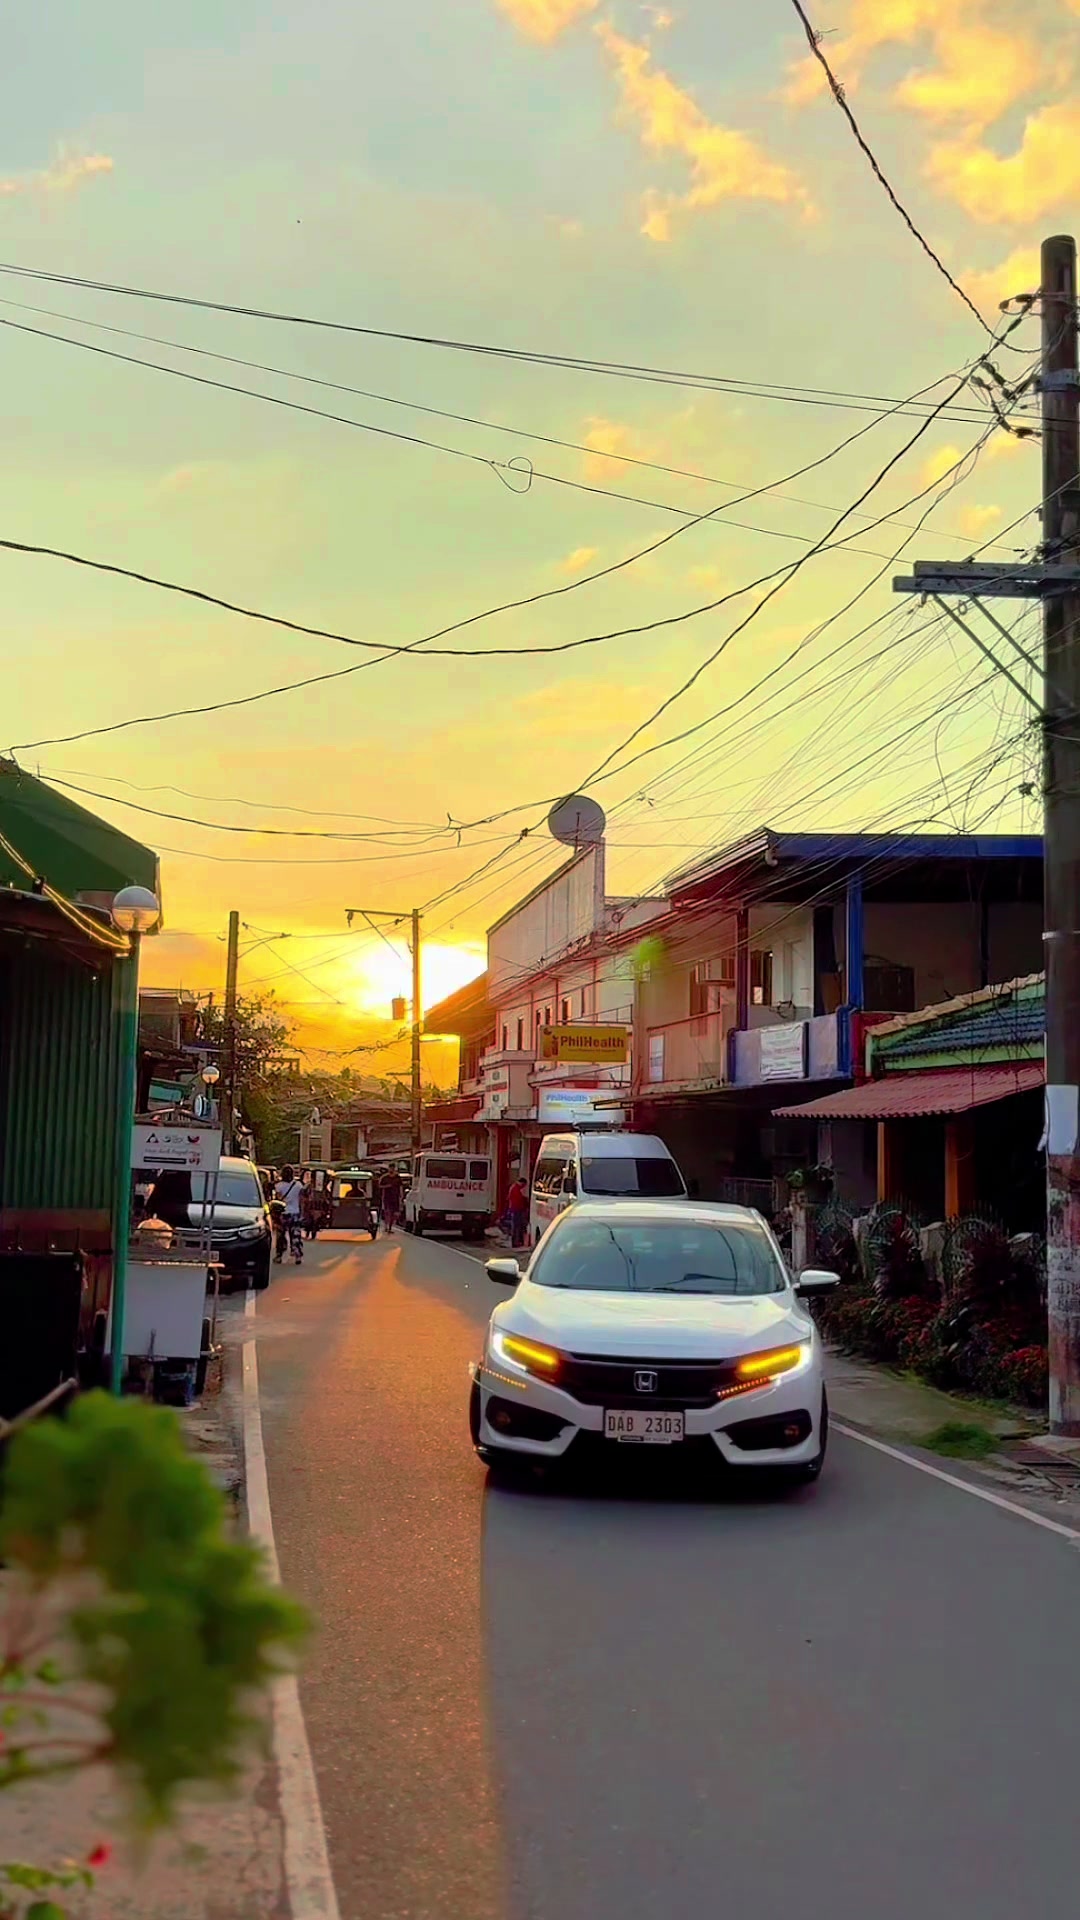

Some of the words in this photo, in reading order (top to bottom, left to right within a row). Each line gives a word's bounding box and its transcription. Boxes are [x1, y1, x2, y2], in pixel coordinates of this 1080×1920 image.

[560, 1035, 625, 1049] PhilHealth
[427, 1180, 485, 1192] AMBULANCE
[608, 1415, 634, 1432] DAB
[645, 1417, 682, 1434] 2303
